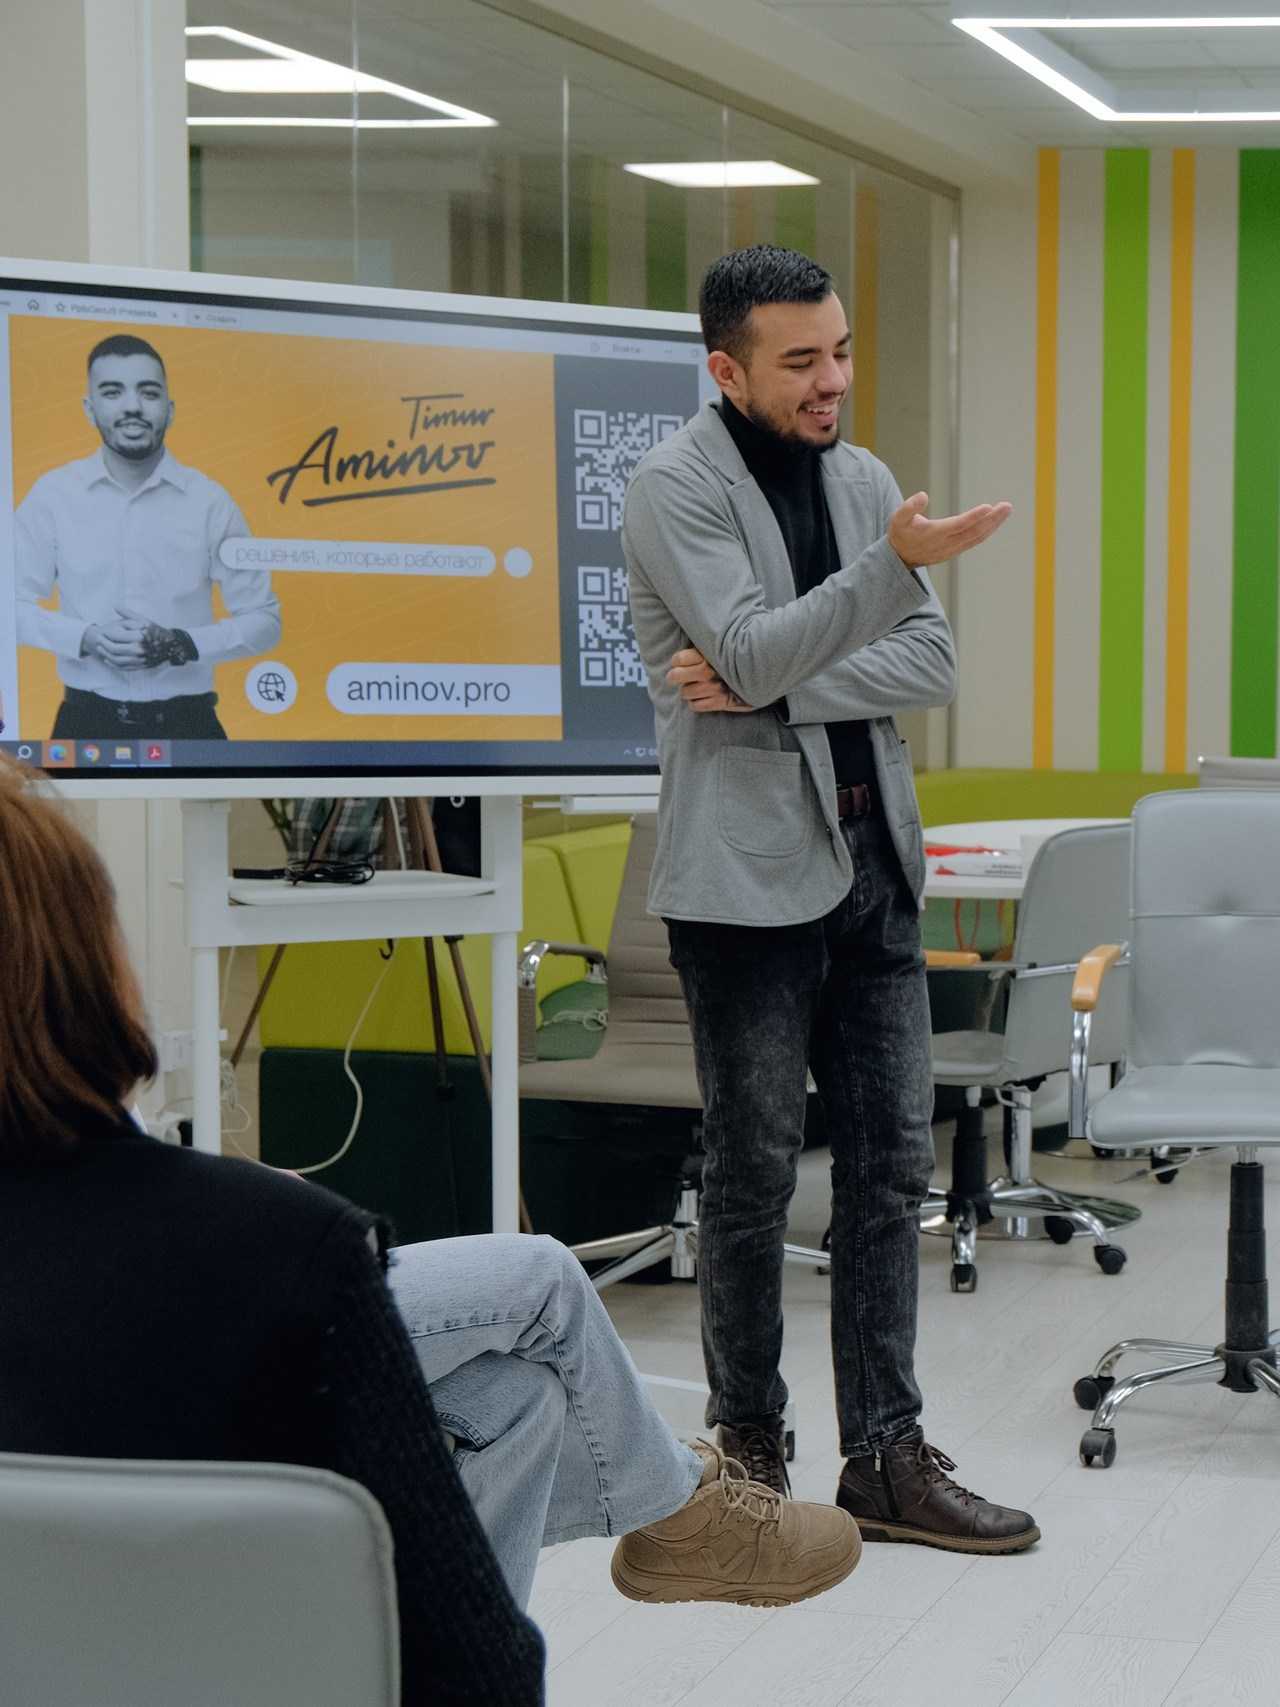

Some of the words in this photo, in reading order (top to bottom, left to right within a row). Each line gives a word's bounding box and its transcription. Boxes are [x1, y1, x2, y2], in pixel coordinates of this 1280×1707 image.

[401, 393, 495, 440] Timur
[266, 426, 496, 506] Aminov
[235, 547, 321, 566] решения,
[326, 549, 399, 570] которые
[404, 551, 485, 572] работают
[347, 674, 511, 708] aminov.pro
